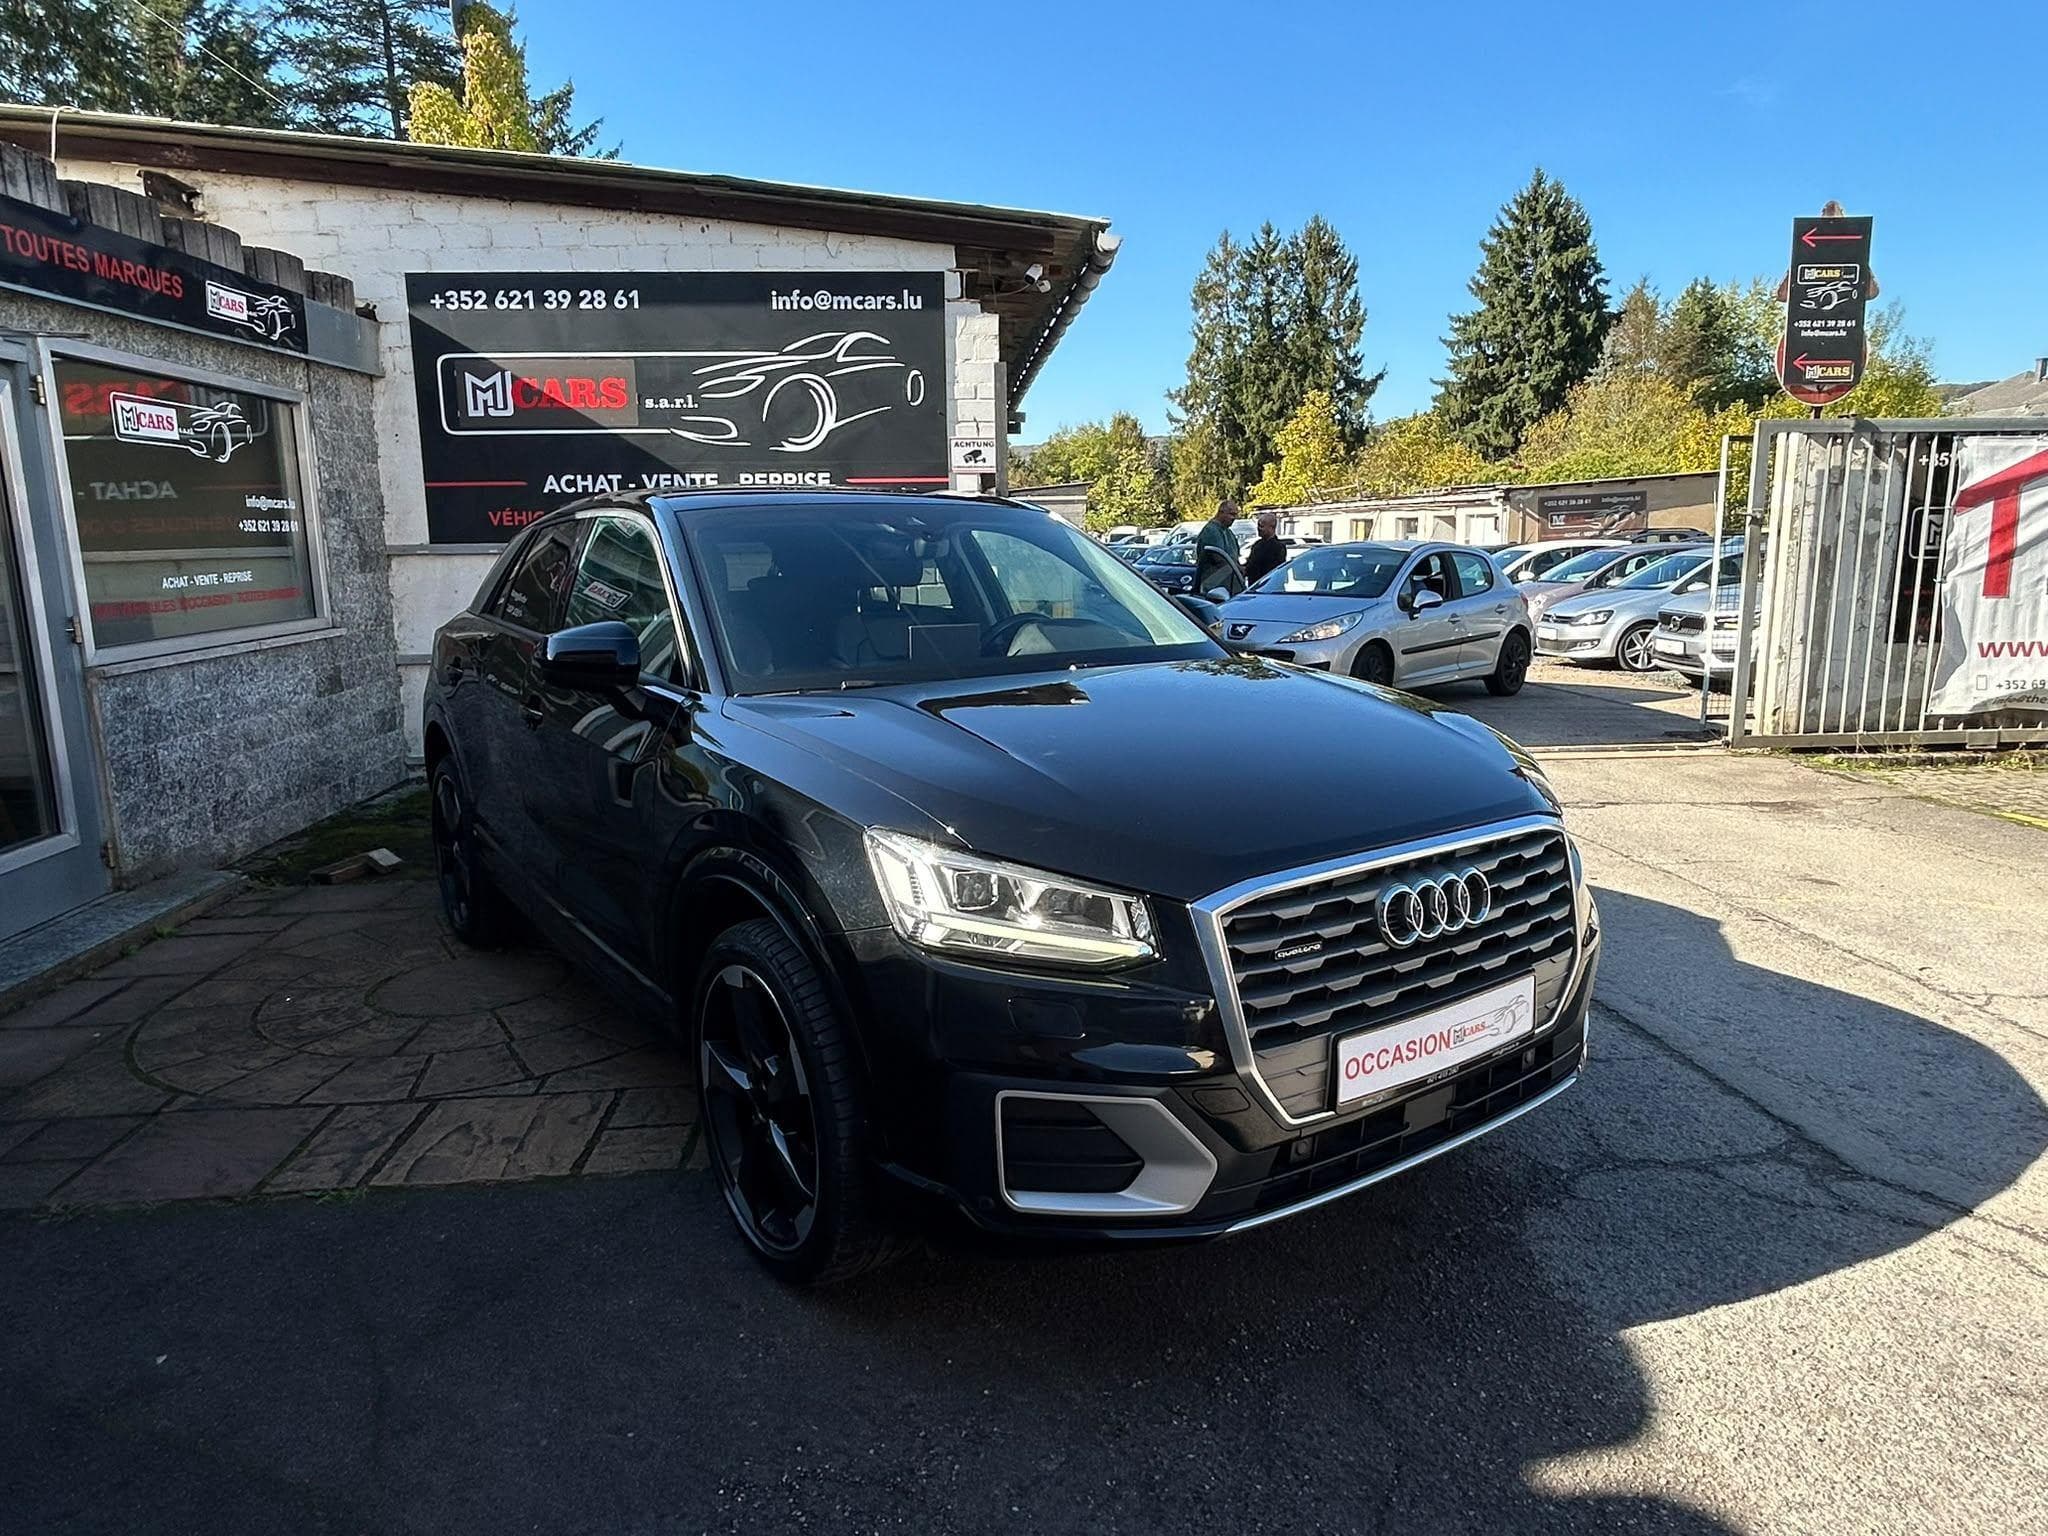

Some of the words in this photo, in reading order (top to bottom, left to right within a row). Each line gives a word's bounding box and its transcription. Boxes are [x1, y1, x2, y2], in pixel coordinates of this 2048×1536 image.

[0, 224, 90, 272] TOUTES
[95, 252, 183, 298] MARQUES
[430, 290, 488, 311] +352
[494, 290, 536, 310] 621
[543, 289, 572, 310] 39
[578, 289, 607, 310] 28
[613, 289, 640, 310] 61
[771, 289, 923, 311] info@mcars.lu
[645, 394, 699, 409] s.a.r.l.
[543, 474, 623, 493] ACHAT
[257, 520, 270, 532] 621
[162, 576, 188, 589] ACHAT
[193, 573, 219, 586] VENTE
[1996, 680, 2026, 690] +352
[1345, 1028, 1452, 1080] OCCASION
